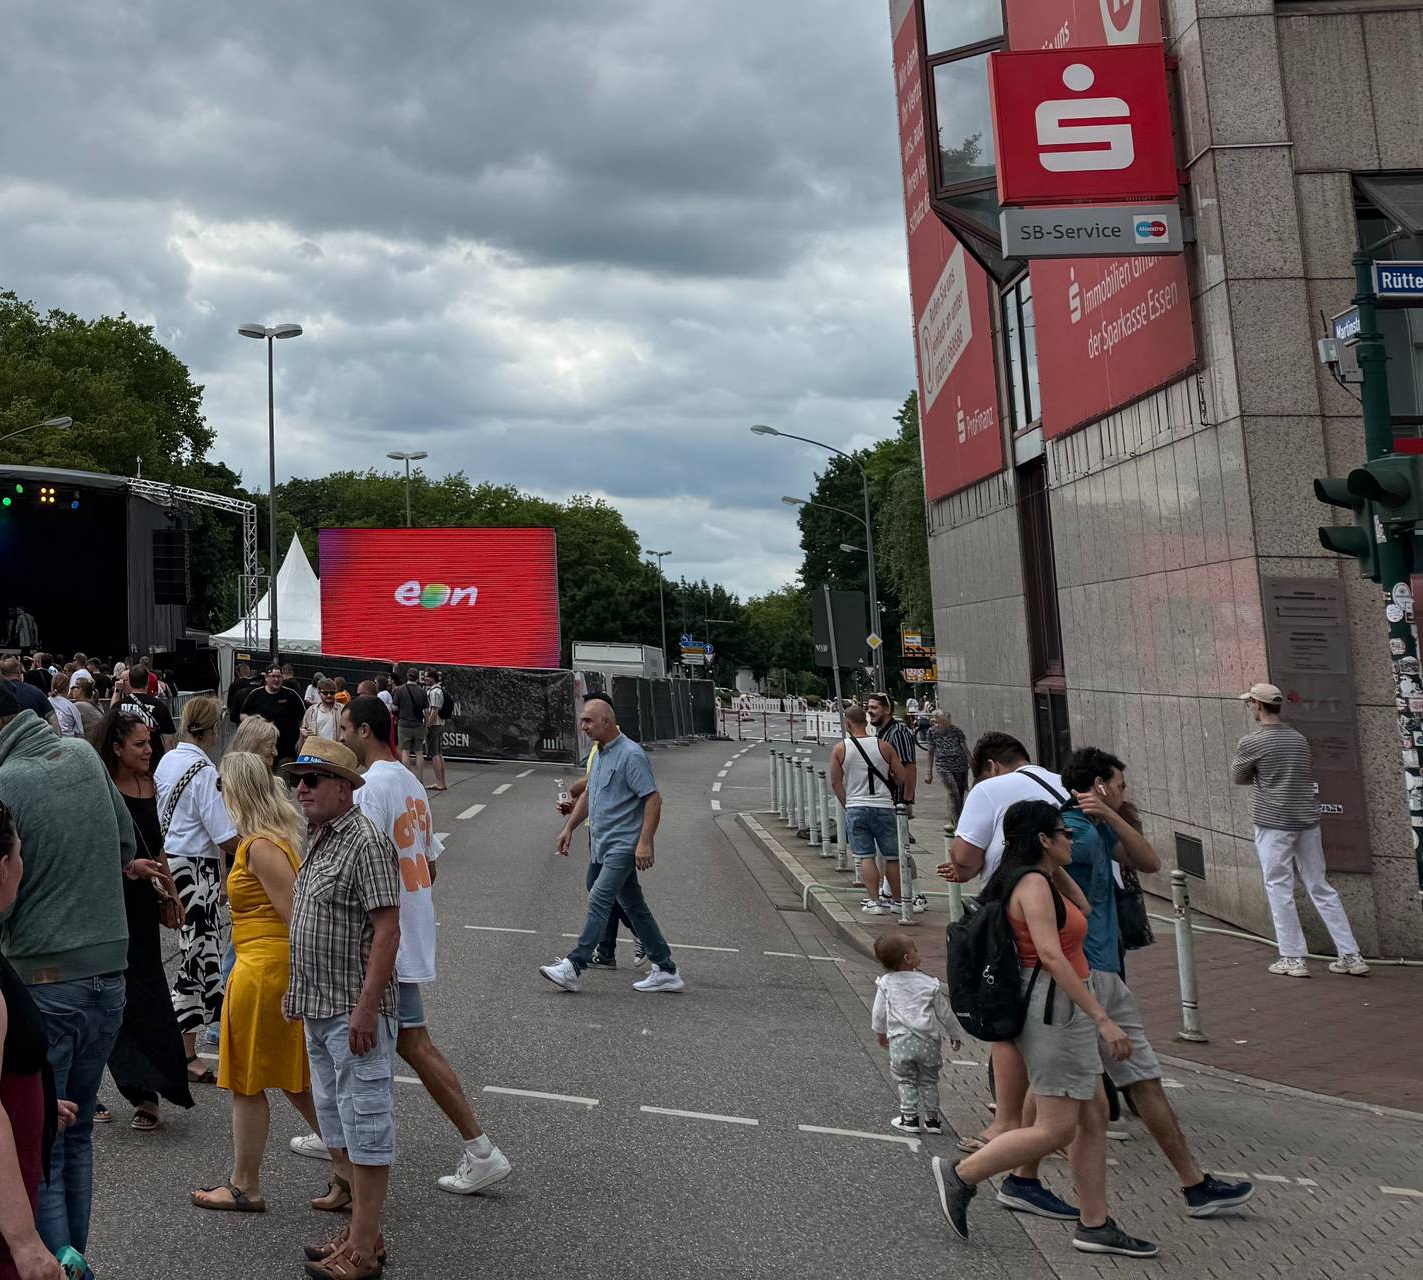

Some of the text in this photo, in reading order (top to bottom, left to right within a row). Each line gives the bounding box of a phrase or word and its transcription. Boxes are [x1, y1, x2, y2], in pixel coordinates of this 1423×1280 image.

[1020, 222, 1122, 240] SB-Service
[1083, 262, 1131, 316] Immobilien
[1088, 282, 1178, 360] der Sparkasse Essen
[441, 732, 470, 747] SSEN
